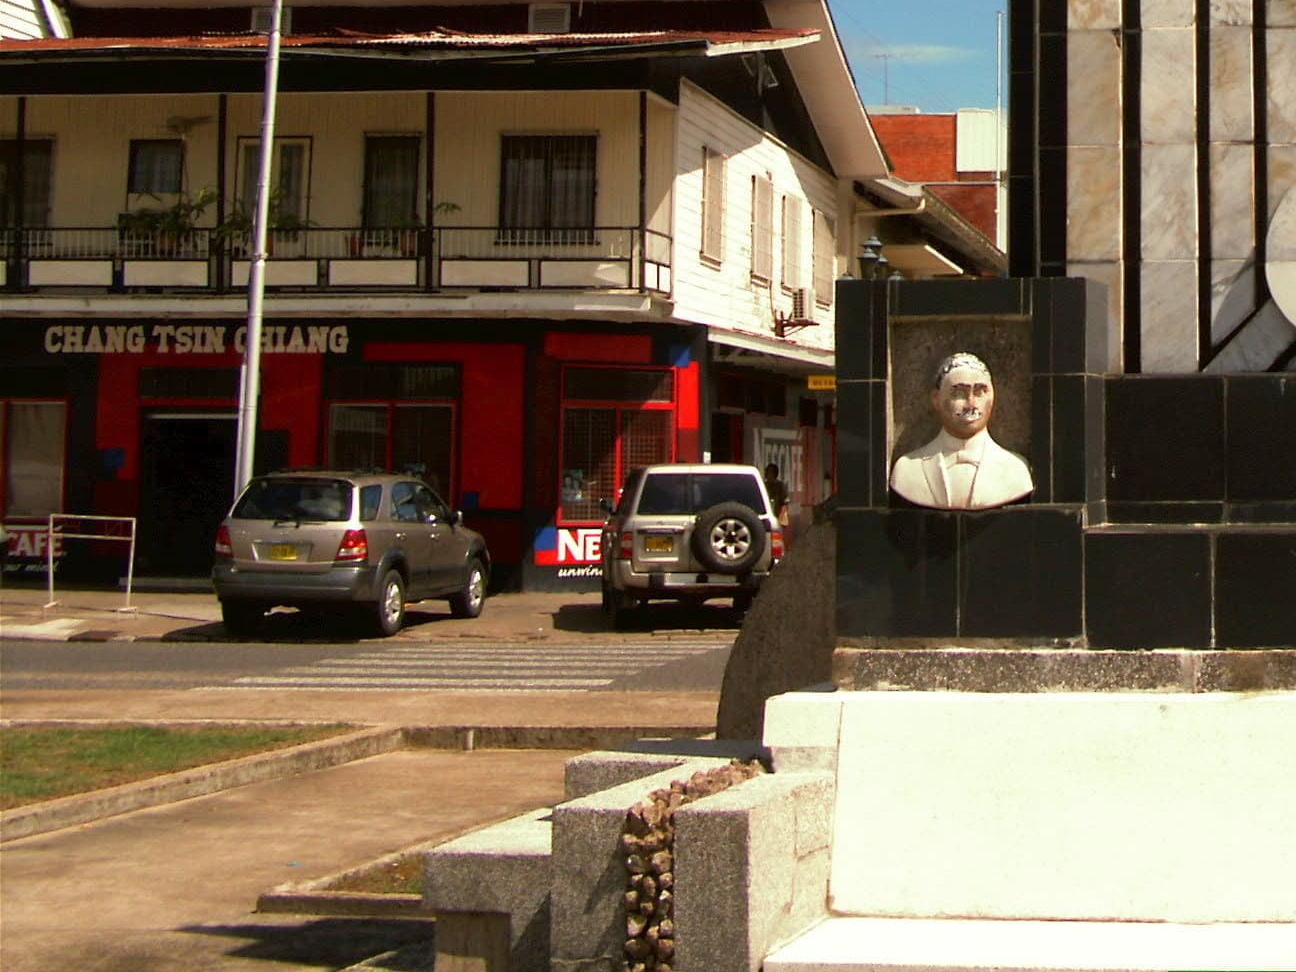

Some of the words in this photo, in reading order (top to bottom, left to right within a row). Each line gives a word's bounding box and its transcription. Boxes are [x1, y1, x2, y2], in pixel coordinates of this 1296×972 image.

[44, 325, 146, 353] CHANG
[152, 326, 226, 353] TSIN
[234, 325, 349, 354] CHIANG
